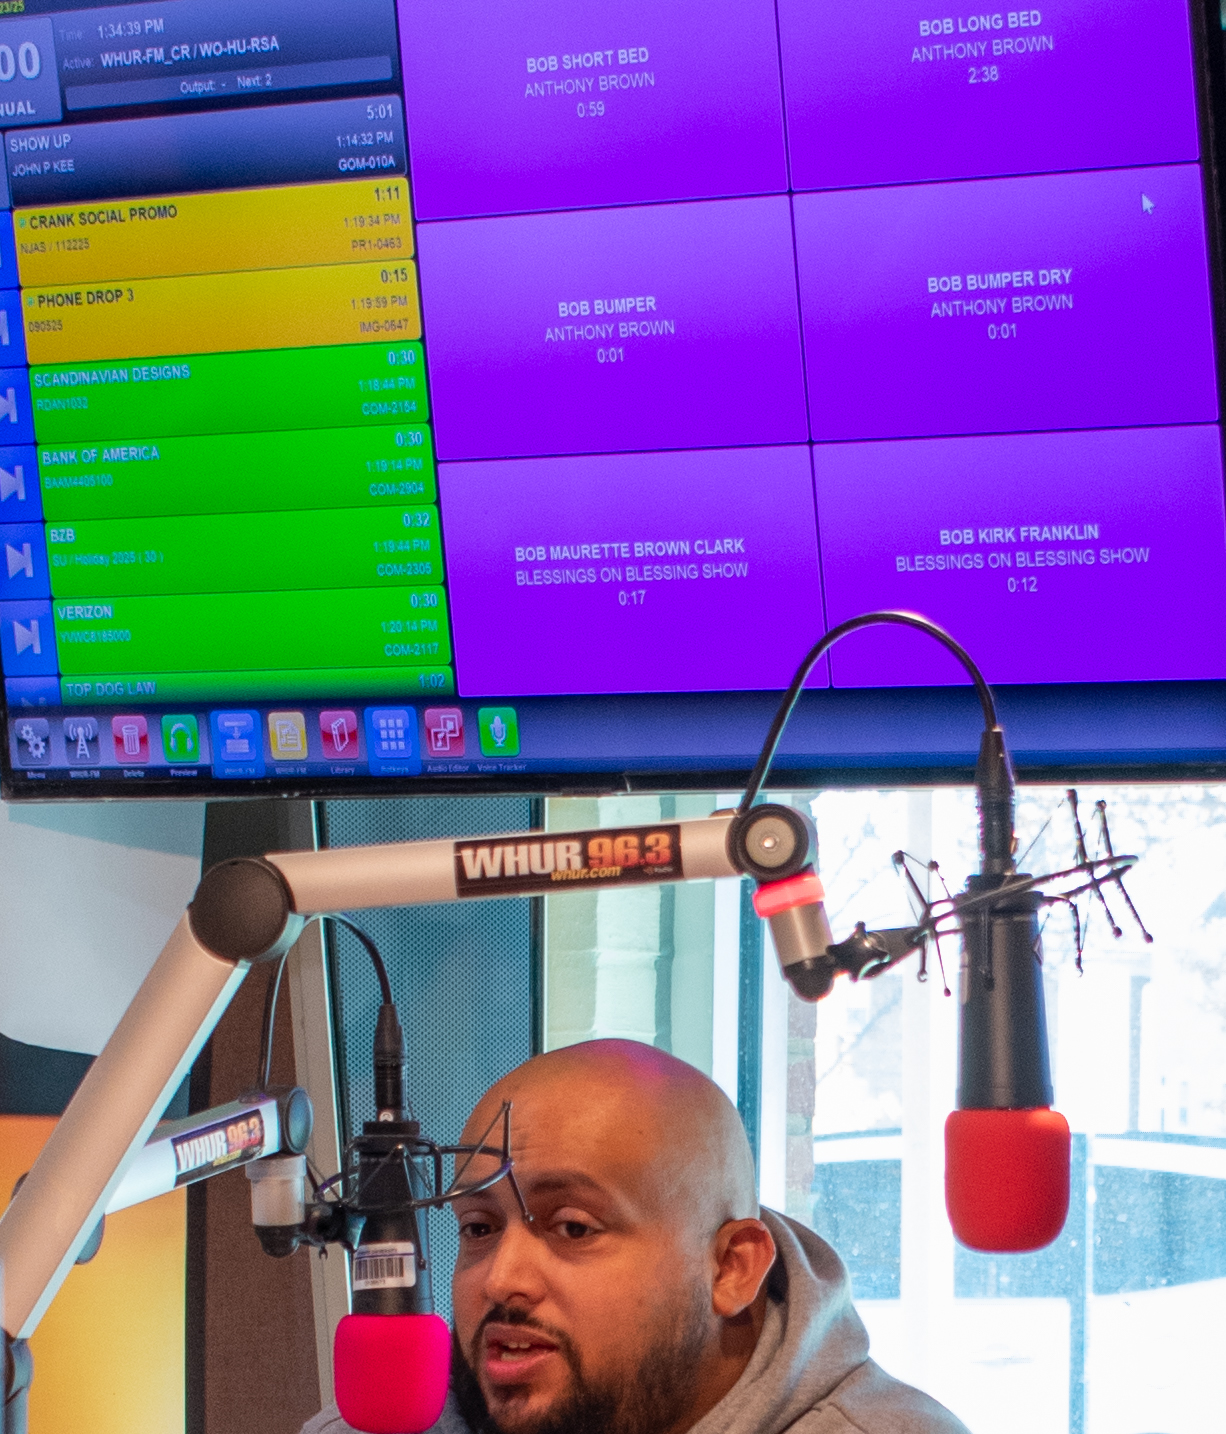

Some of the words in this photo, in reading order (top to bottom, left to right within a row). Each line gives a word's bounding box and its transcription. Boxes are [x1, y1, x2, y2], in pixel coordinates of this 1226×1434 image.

[98, 22, 141, 39] 1:34:39
[145, 18, 165, 34] PM
[919, 18, 954, 37] BOB
[958, 14, 1003, 33] LONG
[1008, 10, 1041, 29] BED
[100, 45, 190, 68] WHUR-FM_CR
[199, 36, 280, 58] WO-HU-RSA
[911, 41, 987, 63] ANTHONY
[992, 35, 1054, 56] BROWN
[526, 56, 558, 73] BOB
[562, 50, 614, 70] SHORT
[618, 47, 649, 65] BED
[968, 65, 999, 84] 2:38
[525, 77, 594, 98] ANTHONY
[599, 72, 655, 91] BROWN
[367, 104, 393, 119] 5:01
[577, 101, 605, 118] 0:59
[10, 136, 50, 153] SHOW
[53, 134, 71, 148] UP
[337, 133, 373, 148] 1:14:32
[377, 131, 393, 144] PM
[13, 162, 42, 177] JOHN
[43, 161, 50, 174] P
[53, 159, 75, 173] KEE
[338, 155, 396, 172] GOM-010A
[374, 186, 400, 201] 1:11
[30, 214, 75, 229] CRANK
[79, 210, 125, 226] SOCIAL
[129, 205, 178, 222] PROMO
[381, 268, 408, 283] 0:15
[928, 275, 962, 293] BOB
[967, 271, 1034, 290] BUMPER
[1038, 268, 1073, 286] DRY
[38, 292, 83, 307] PHONE
[87, 289, 123, 305] DROP
[128, 288, 134, 301] 3
[558, 301, 590, 318] BOB
[594, 296, 656, 315] BUMPER
[931, 298, 1007, 318] ANTHONY
[1012, 294, 1073, 314] BROWN
[545, 324, 614, 342] ANTHONY
[619, 320, 675, 338] BROWN
[988, 323, 1017, 340] 0:01
[388, 350, 416, 365] 0:30
[597, 347, 624, 364] 0:01
[34, 369, 129, 388] SCANDINAVIAN
[132, 365, 190, 382] DESIGNS
[395, 432, 423, 447] 0:30
[42, 450, 78, 466] BANK
[81, 449, 98, 463] OF
[102, 446, 160, 463] AMERICA
[403, 513, 431, 528] 0:32
[50, 528, 76, 543] BZB
[940, 529, 974, 546] BOB
[978, 527, 1017, 544] KIRK
[1020, 524, 1099, 543] FRANKLIN
[515, 546, 547, 562] BOB
[550, 543, 630, 560] MAURETTE
[634, 540, 690, 558] BROWN
[694, 538, 745, 555] CLARK
[896, 553, 984, 572] BLESSINGS
[988, 552, 1012, 569] ON
[1016, 549, 1095, 568] BLESSING
[1099, 547, 1150, 565] SHOW
[516, 568, 596, 586] BLESSINGS
[601, 567, 622, 583] ON
[626, 564, 698, 582] BLESSING
[702, 562, 748, 579] SHOW
[1007, 576, 1038, 593] 0:12
[411, 594, 438, 608] 0:30
[618, 589, 646, 606] 0:17
[58, 605, 114, 620] VERIZON
[66, 683, 92, 697] TOP
[96, 682, 123, 696] DOG
[127, 681, 156, 695] LAW
[419, 673, 445, 688] 1:02
[461, 840, 583, 880] WHUR
[588, 833, 671, 869] 96.3
[551, 866, 621, 882] whur.com
[176, 1129, 228, 1171] WHUR
